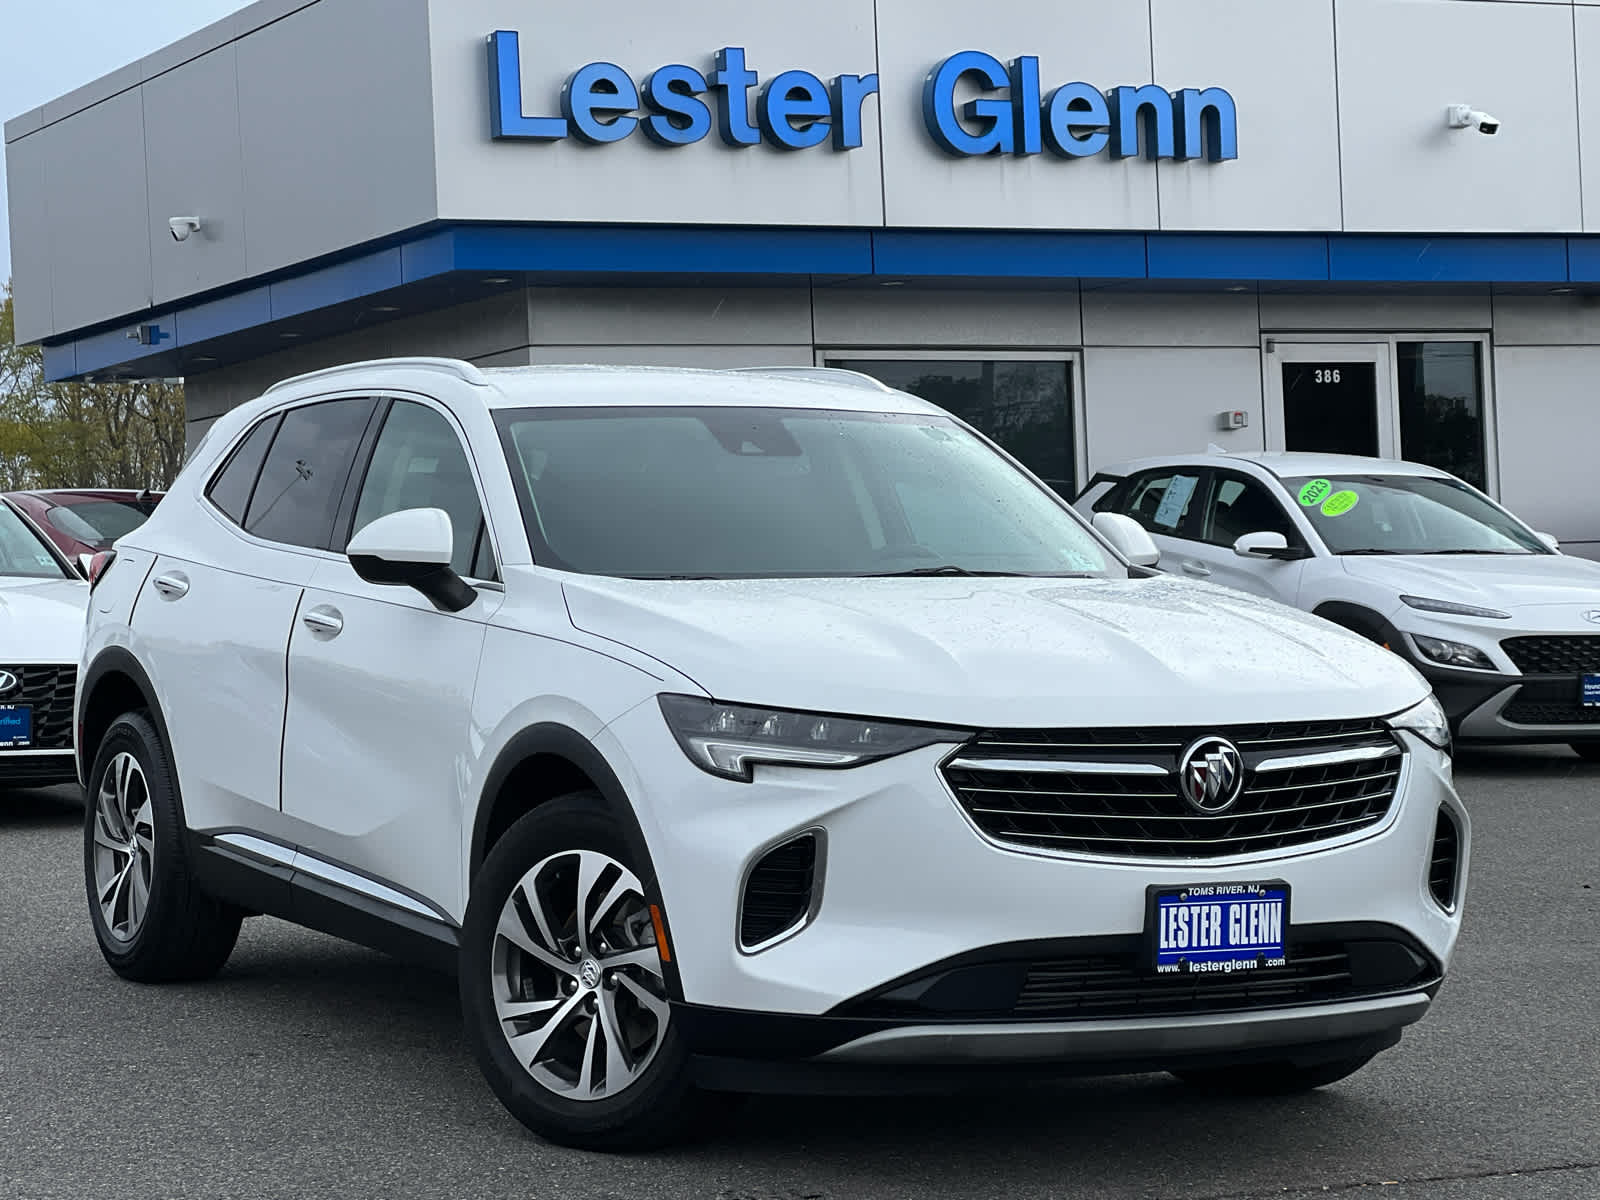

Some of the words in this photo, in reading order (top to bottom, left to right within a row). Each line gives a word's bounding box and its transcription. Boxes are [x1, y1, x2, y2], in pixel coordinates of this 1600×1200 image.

[486, 30, 878, 151] Lester
[923, 50, 1238, 161] Glenn
[1315, 369, 1340, 383] 386
[1302, 480, 1329, 504] 2023
[1188, 887, 1214, 896] TOMS
[1247, 885, 1260, 893] NJ
[1160, 905, 1222, 949] LESTER
[1229, 902, 1282, 945] GLENN
[1157, 964, 1180, 973] www.
[1189, 959, 1257, 973] lesterglenn
[1265, 958, 1286, 967] .com
